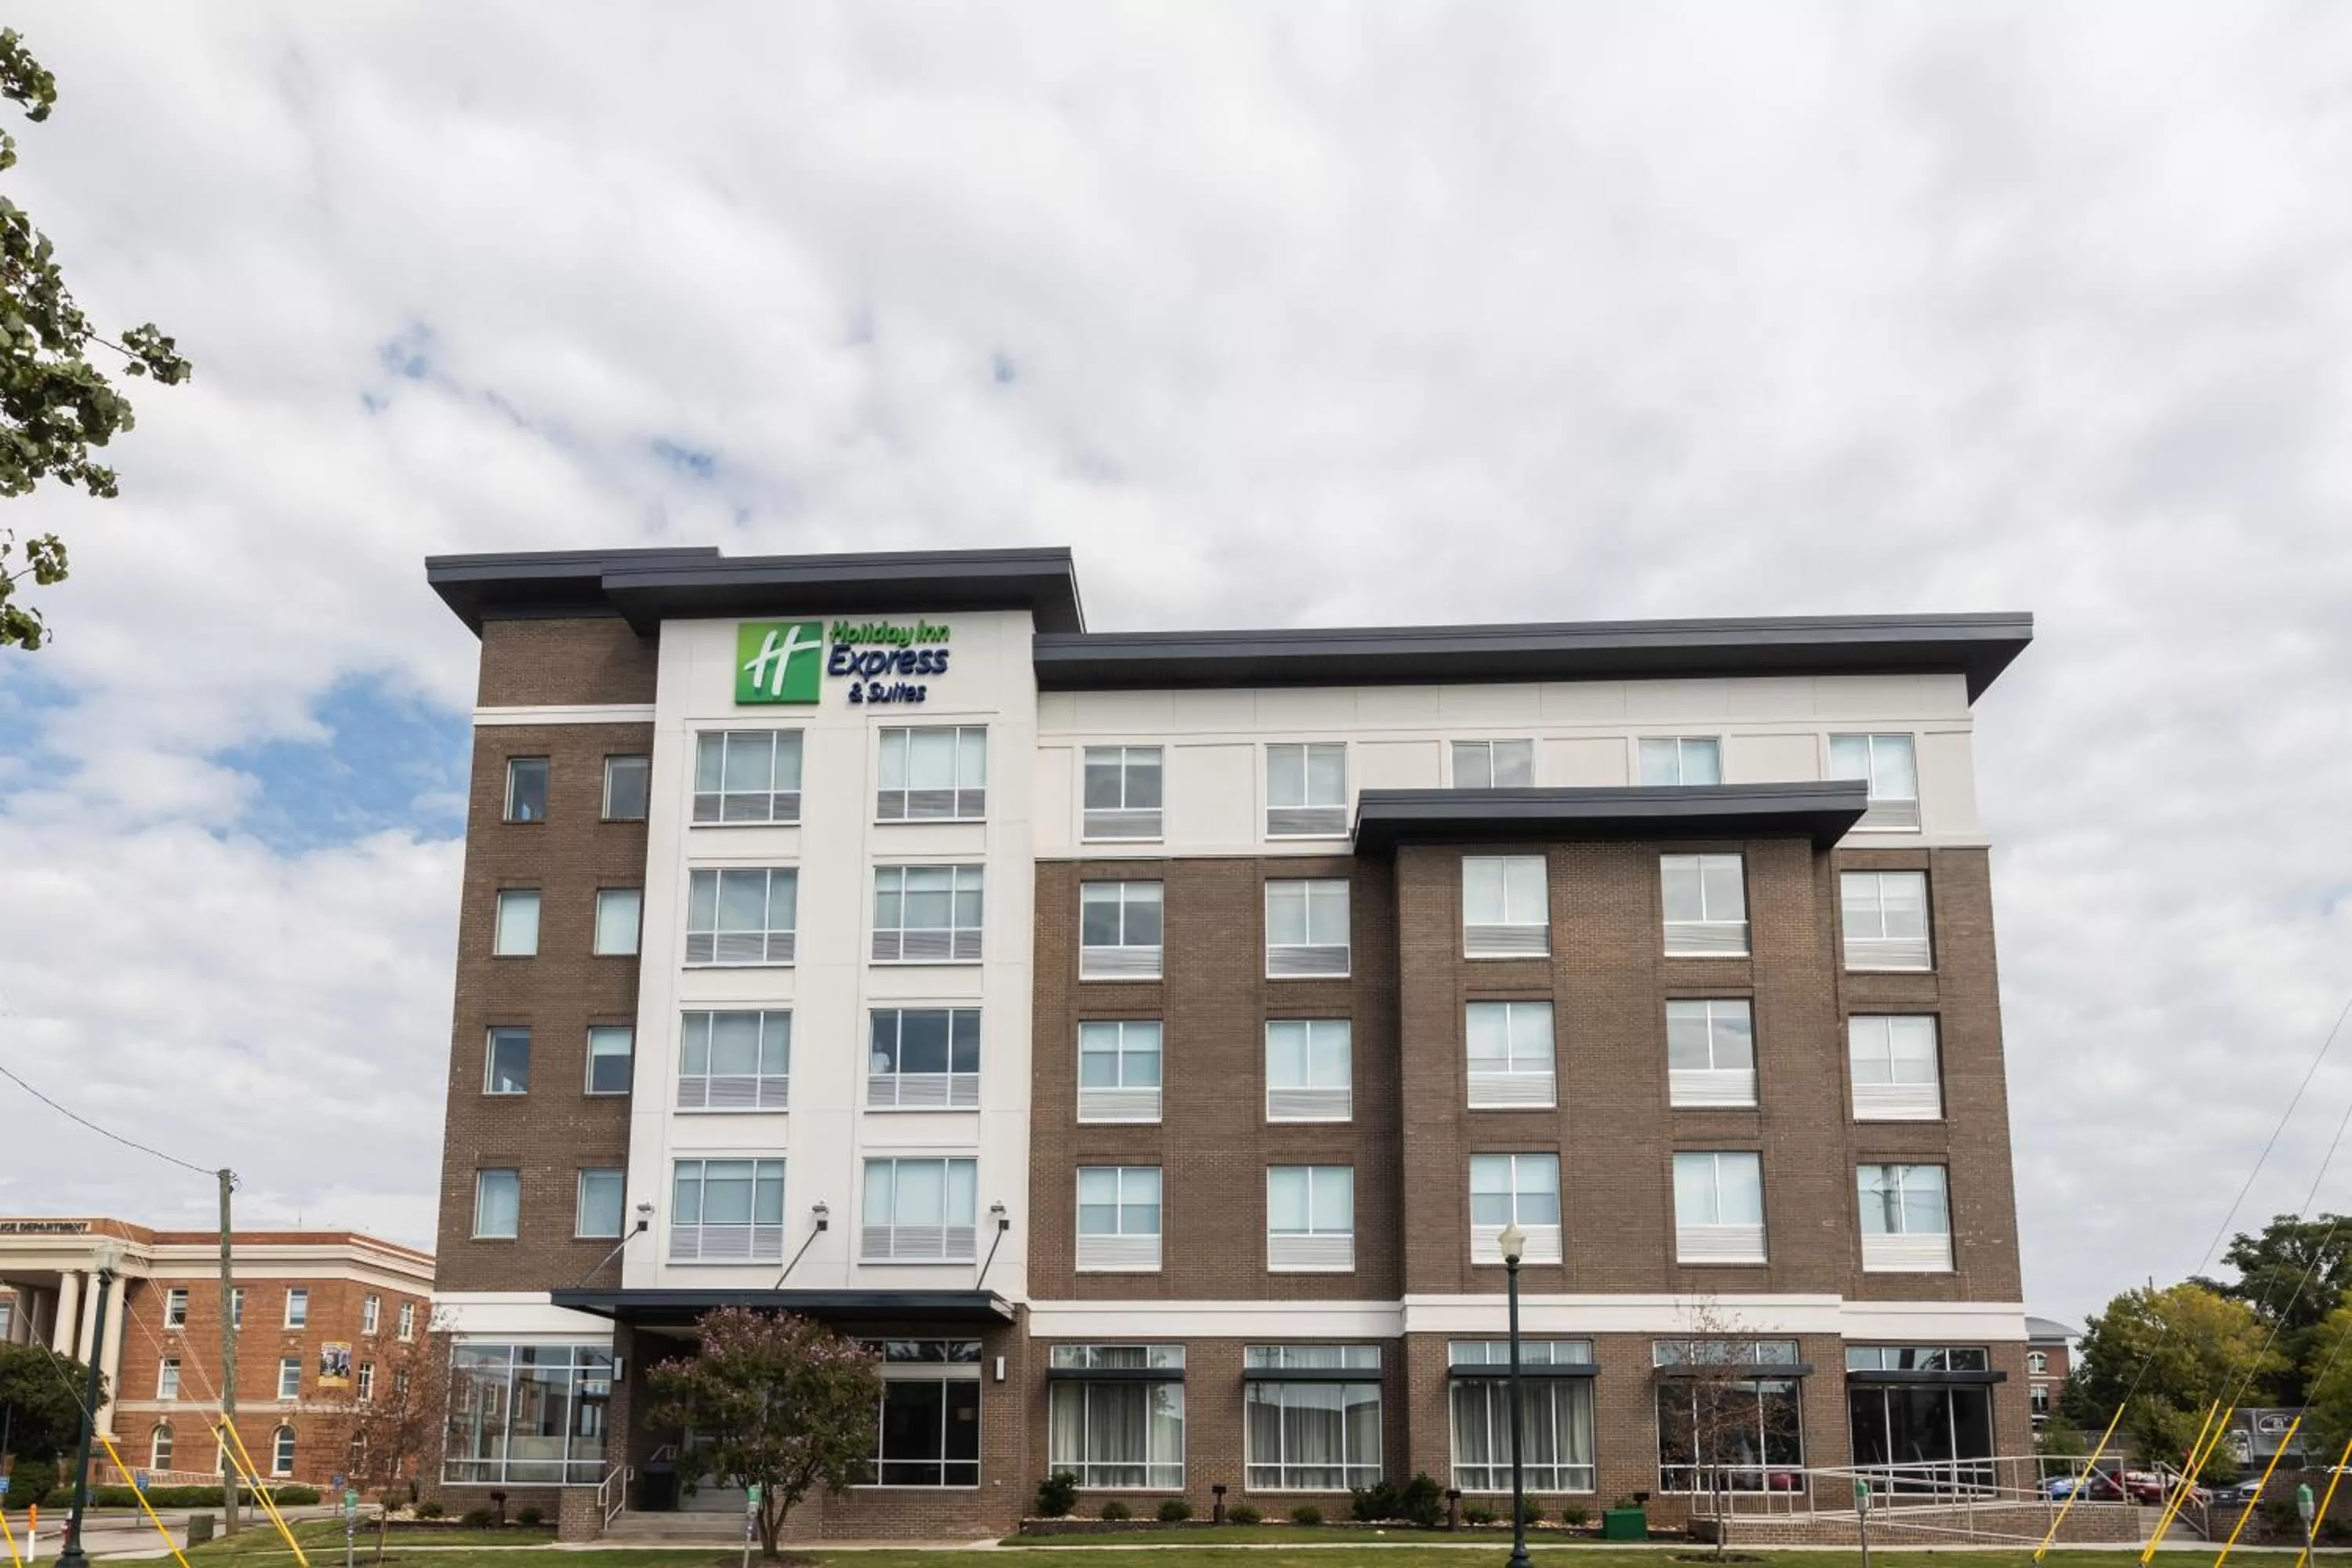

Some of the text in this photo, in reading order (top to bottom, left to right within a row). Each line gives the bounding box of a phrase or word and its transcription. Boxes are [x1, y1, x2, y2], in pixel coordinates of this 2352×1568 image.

[829, 619, 950, 647] Holiday Inn
[827, 644, 949, 681] Express
[848, 681, 927, 703] & Suites
[20, 1222, 88, 1231] DEPARTMENT
